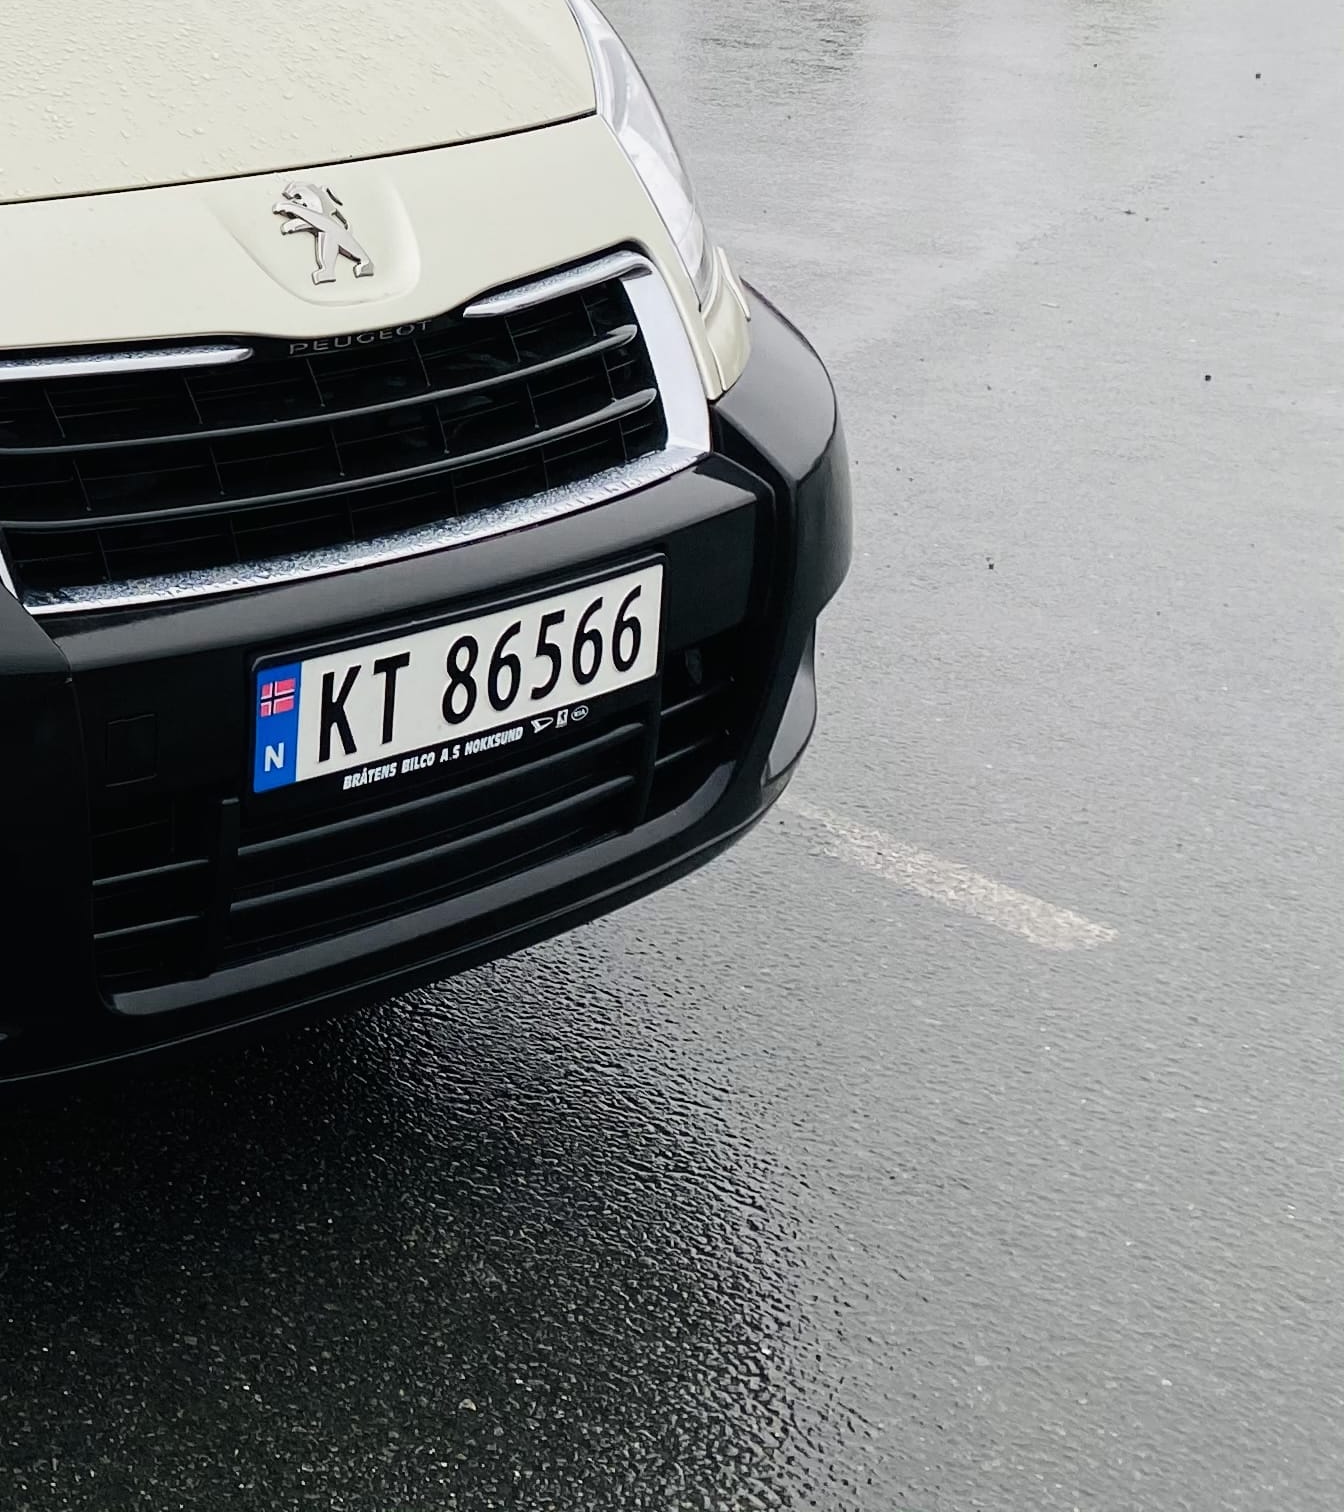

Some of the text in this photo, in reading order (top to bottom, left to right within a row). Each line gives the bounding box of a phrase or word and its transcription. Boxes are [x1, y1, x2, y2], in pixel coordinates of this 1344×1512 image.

[289, 319, 433, 355] PEUGEOT
[318, 584, 643, 763] KT 86566
[264, 742, 285, 773] N
[342, 762, 398, 790] BRÅTENS
[401, 751, 436, 774] BILCO
